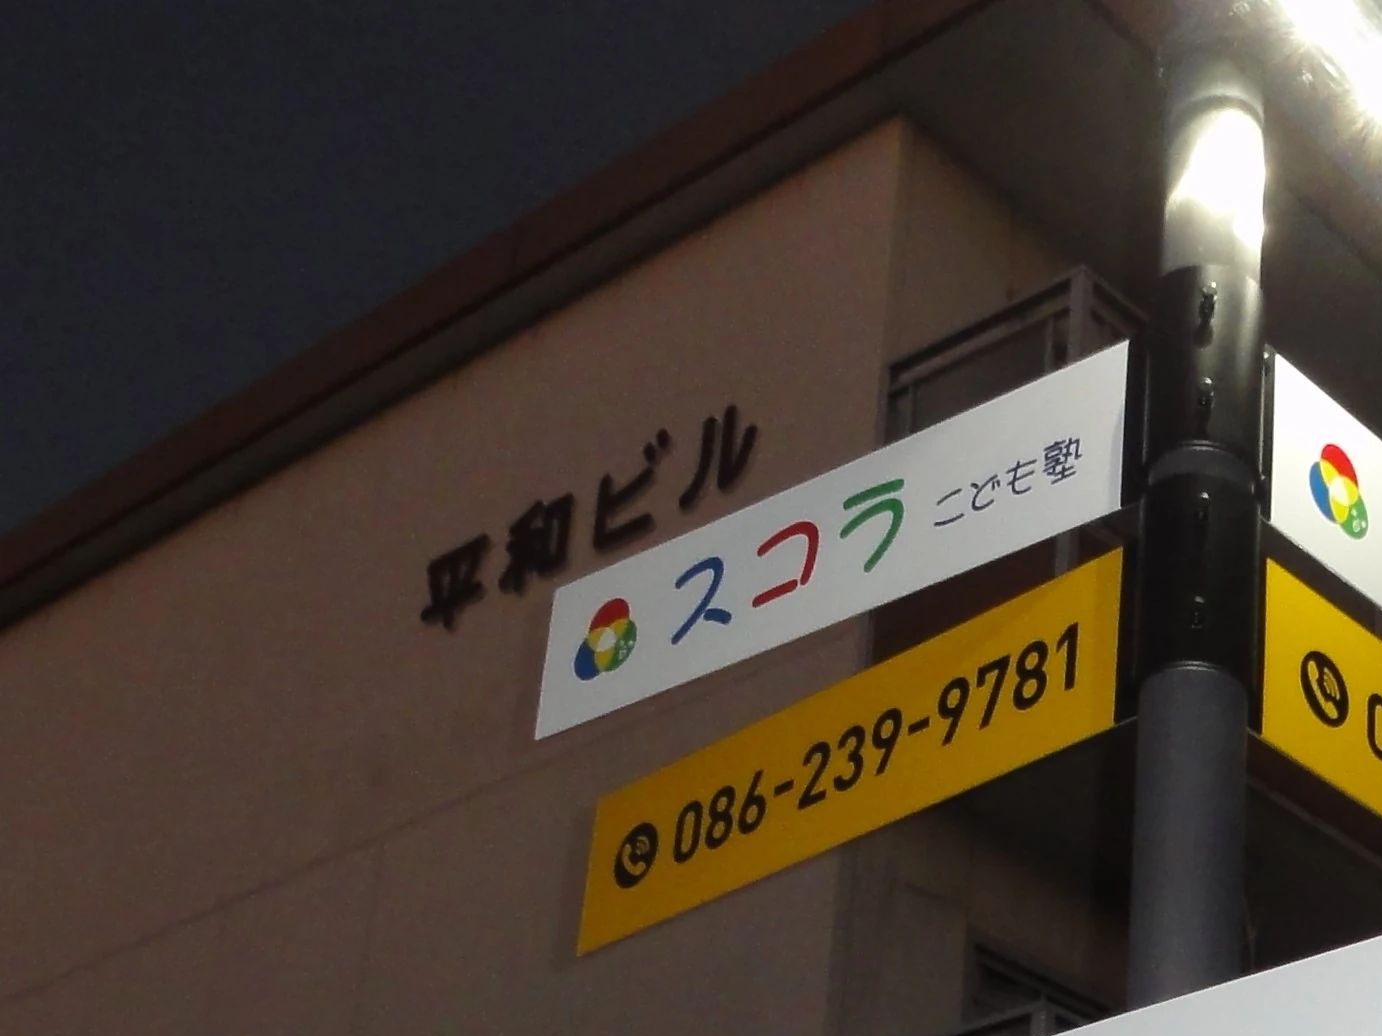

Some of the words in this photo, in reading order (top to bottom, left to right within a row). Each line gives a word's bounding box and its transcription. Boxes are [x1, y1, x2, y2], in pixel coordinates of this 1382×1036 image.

[420, 404, 758, 632] 平和ビル
[670, 478, 905, 644] スコラ
[934, 437, 1082, 527] こども塾
[672, 622, 1080, 863] 086-239-9781
